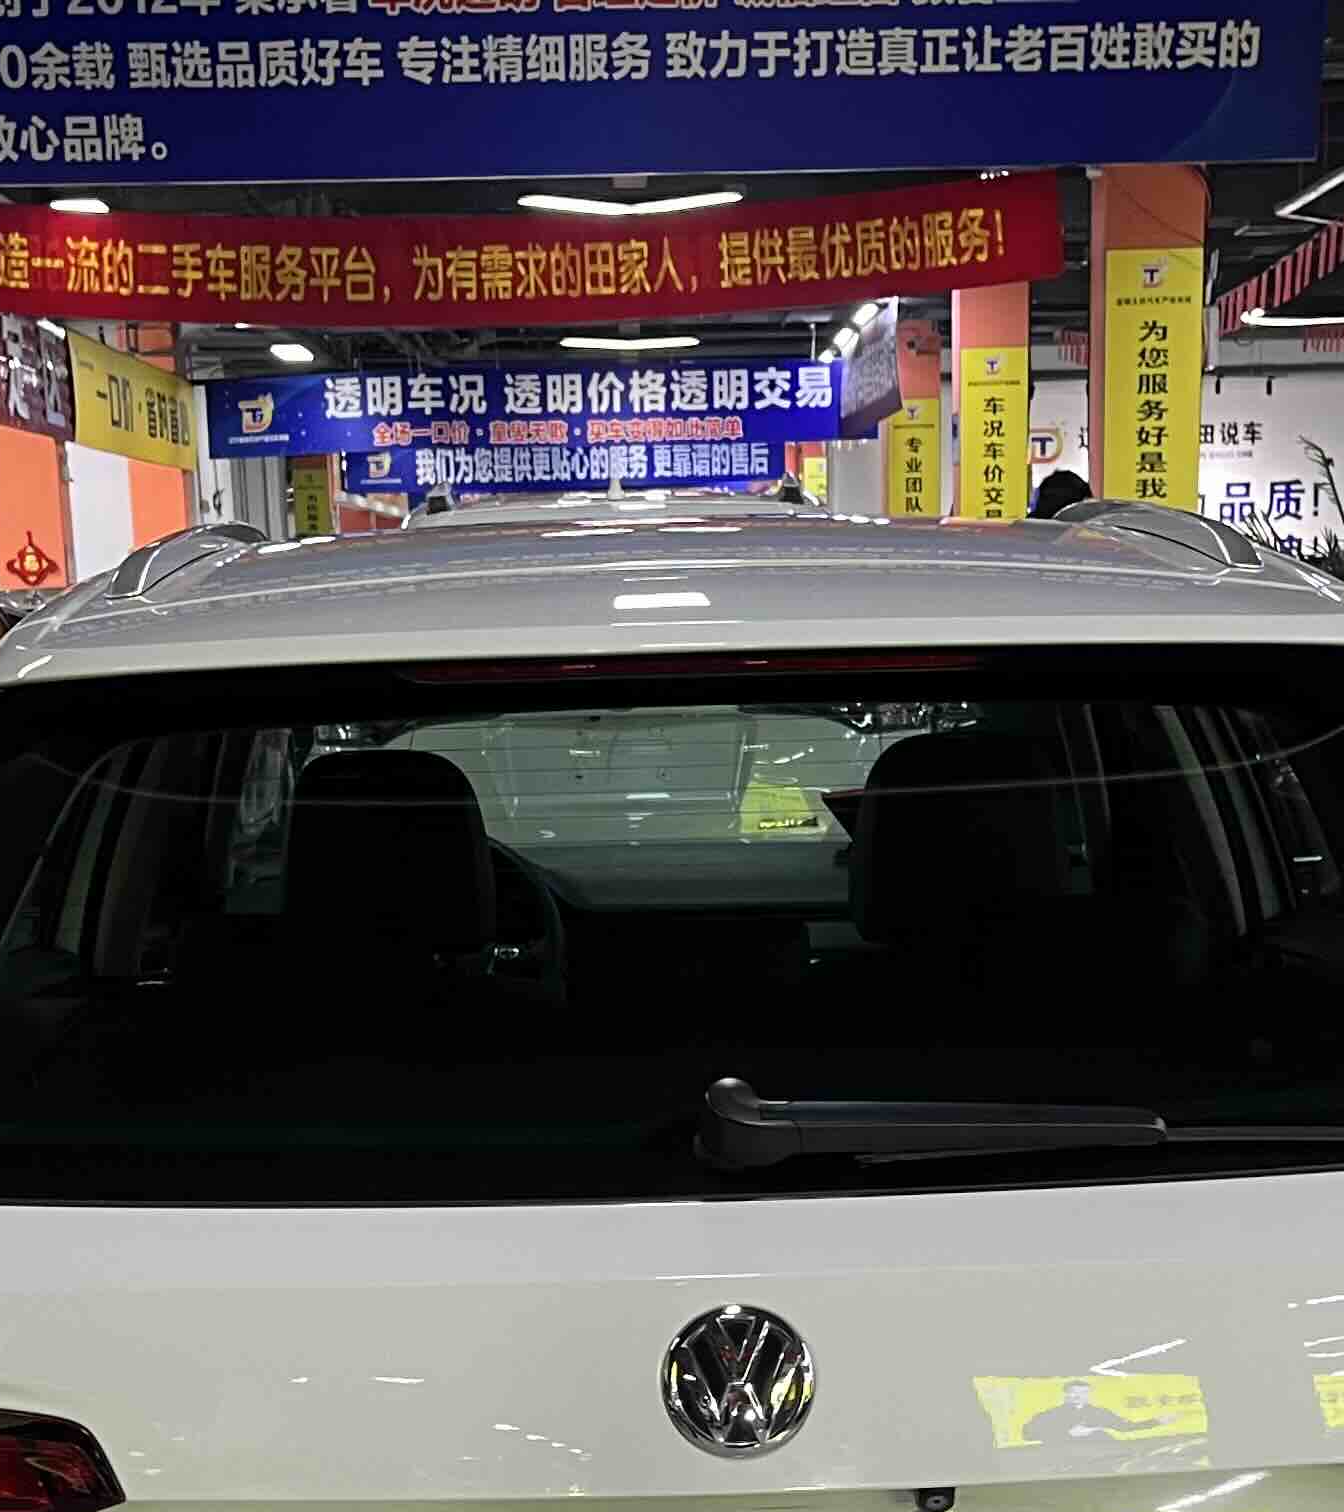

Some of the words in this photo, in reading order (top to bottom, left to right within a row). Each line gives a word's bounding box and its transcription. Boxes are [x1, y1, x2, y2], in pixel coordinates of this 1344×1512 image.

[127, 36, 384, 89] 甄选品质好车
[398, 31, 652, 84] 专注精细服务
[665, 19, 1260, 80] 致力于打造真正让老百姓敢买的
[324, 374, 487, 419] 透明车况
[905, 436, 923, 513] 专业团队
